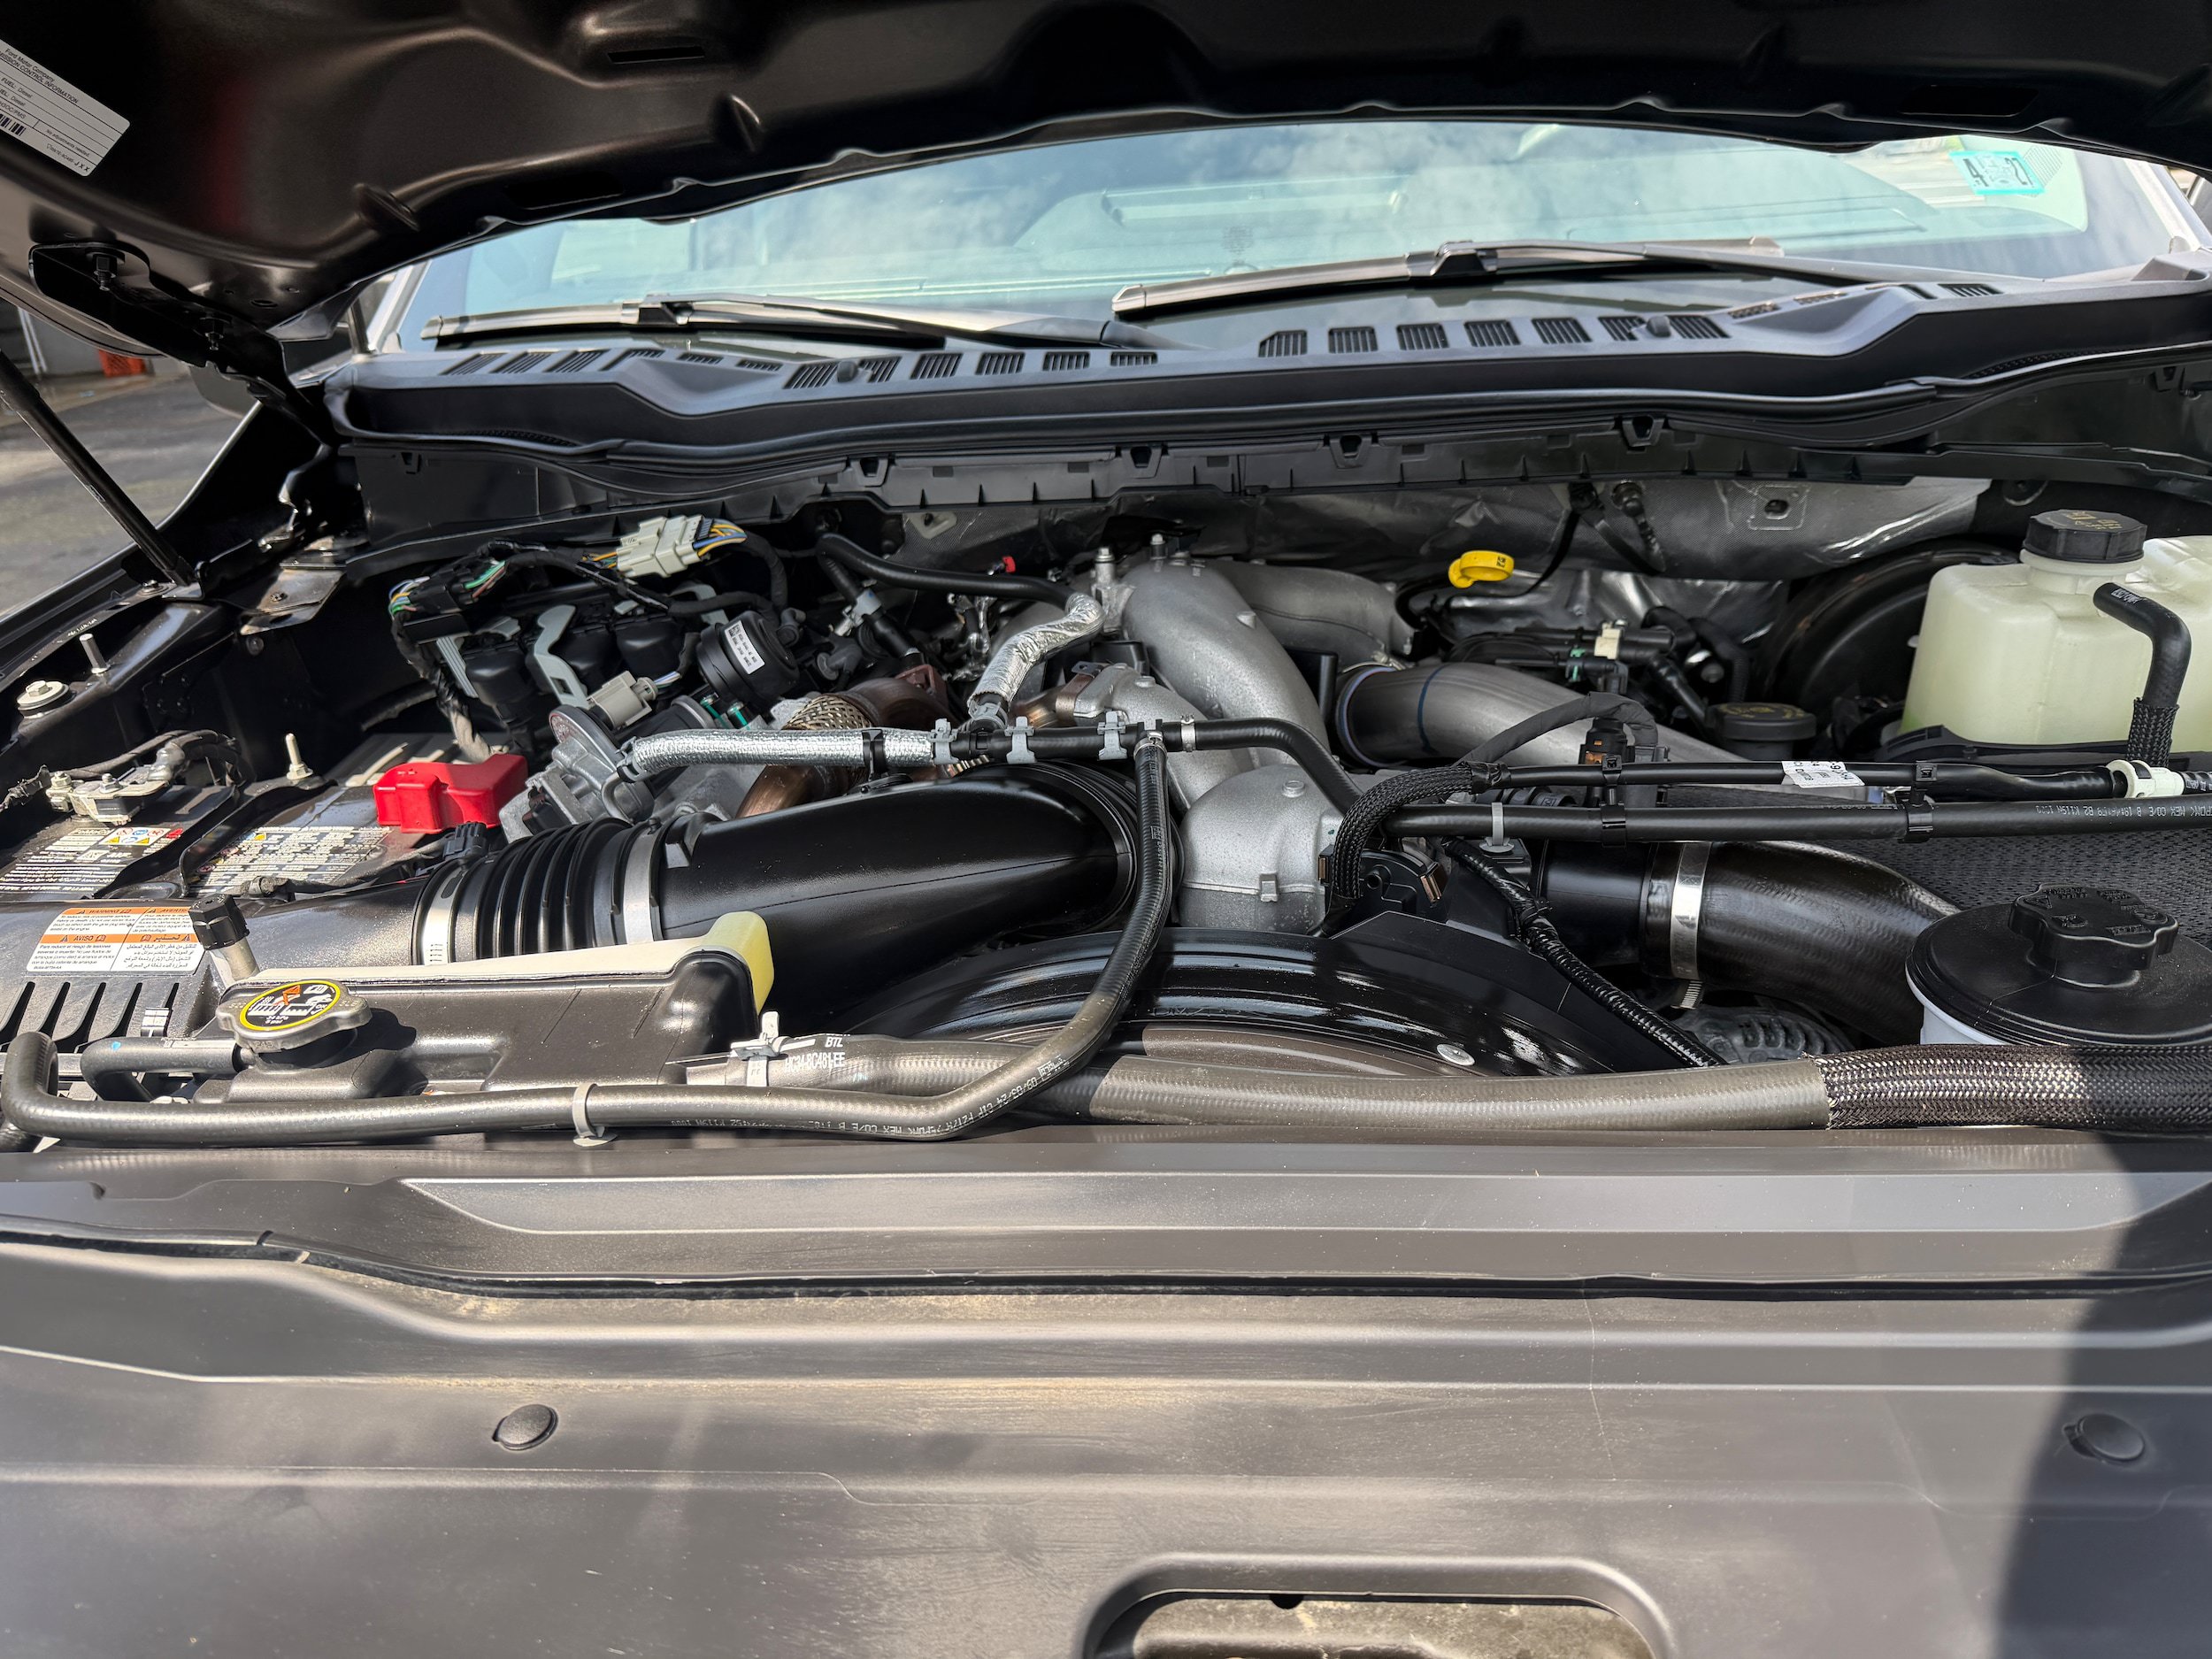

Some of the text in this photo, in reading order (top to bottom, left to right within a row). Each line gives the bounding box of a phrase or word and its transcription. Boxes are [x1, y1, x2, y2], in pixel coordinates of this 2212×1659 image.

[19, 64, 44, 82] CONTROL
[43, 80, 78, 104] INFORMATION
[30, 65, 56, 84] Company
